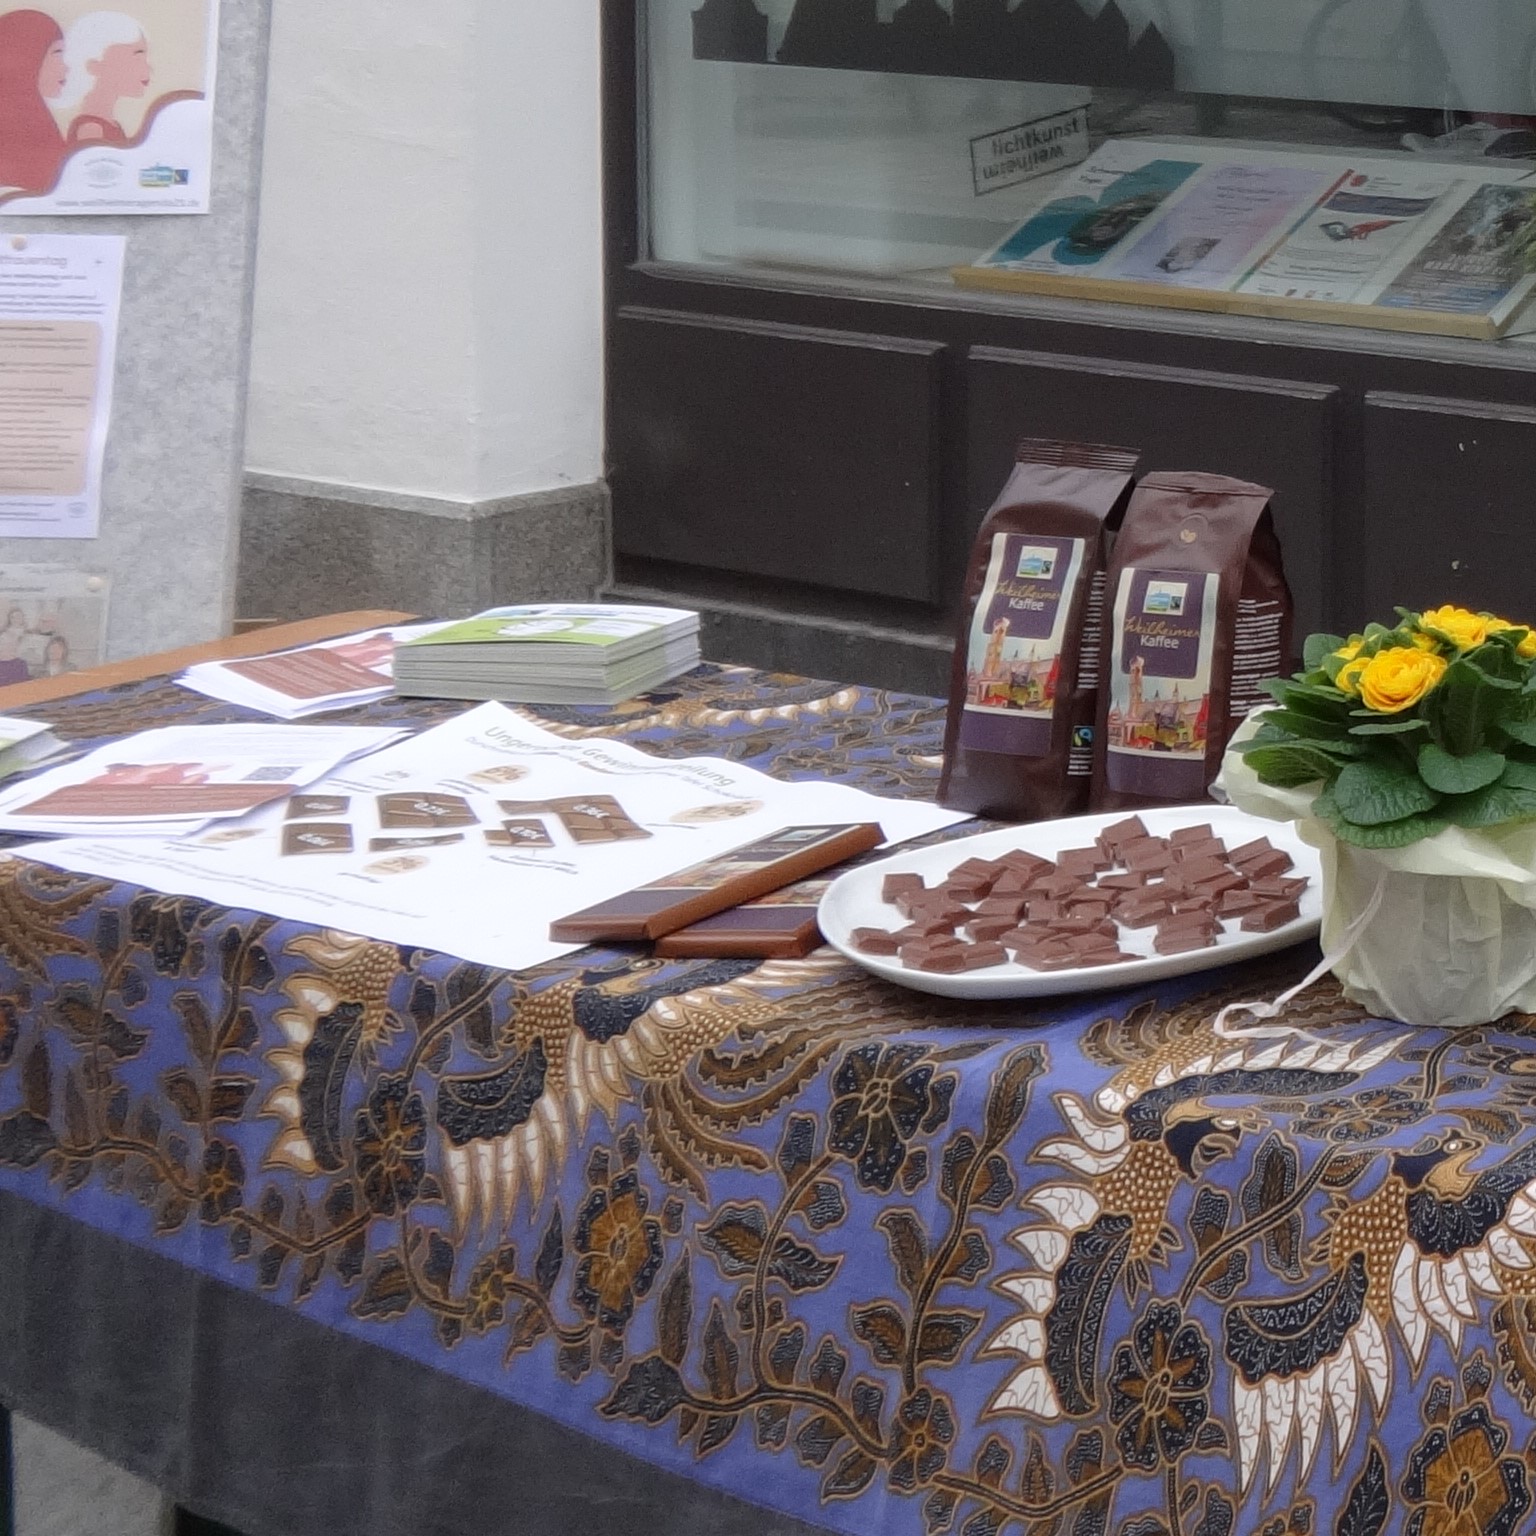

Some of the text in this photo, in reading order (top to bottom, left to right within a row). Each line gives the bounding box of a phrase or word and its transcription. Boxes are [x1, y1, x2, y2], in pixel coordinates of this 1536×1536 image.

[992, 116, 1081, 156] lichtkunst
[1008, 597, 1045, 611] Kaffee
[1124, 615, 1200, 639] Weilheimer
[1140, 634, 1180, 650] Kaffee
